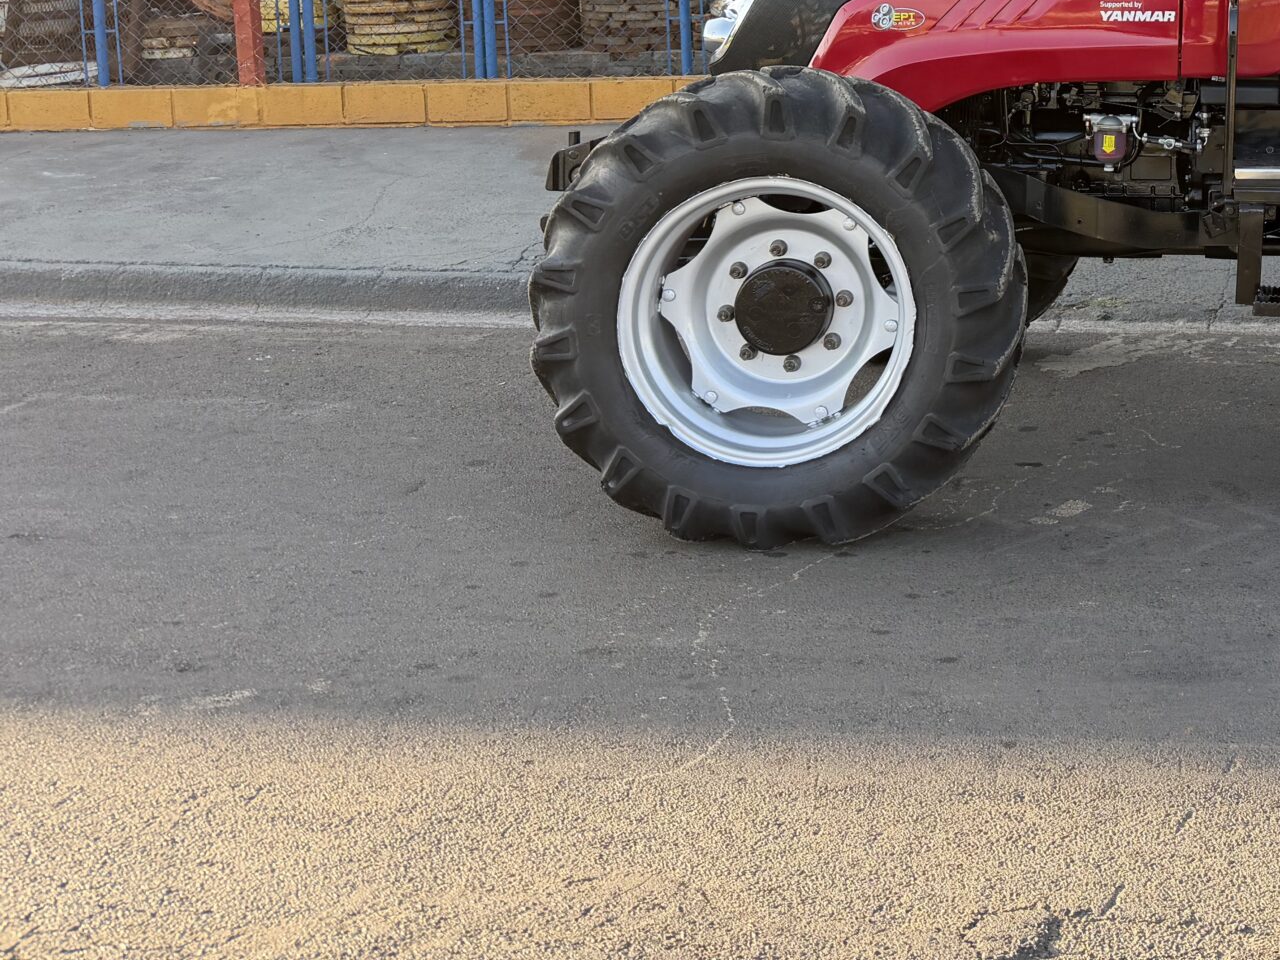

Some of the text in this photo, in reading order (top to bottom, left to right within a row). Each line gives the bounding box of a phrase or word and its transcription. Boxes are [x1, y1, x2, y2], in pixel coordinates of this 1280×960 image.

[1099, 1, 1142, 10] Supported by
[892, 12, 916, 22] EPI
[1099, 10, 1176, 22] YANMAR
